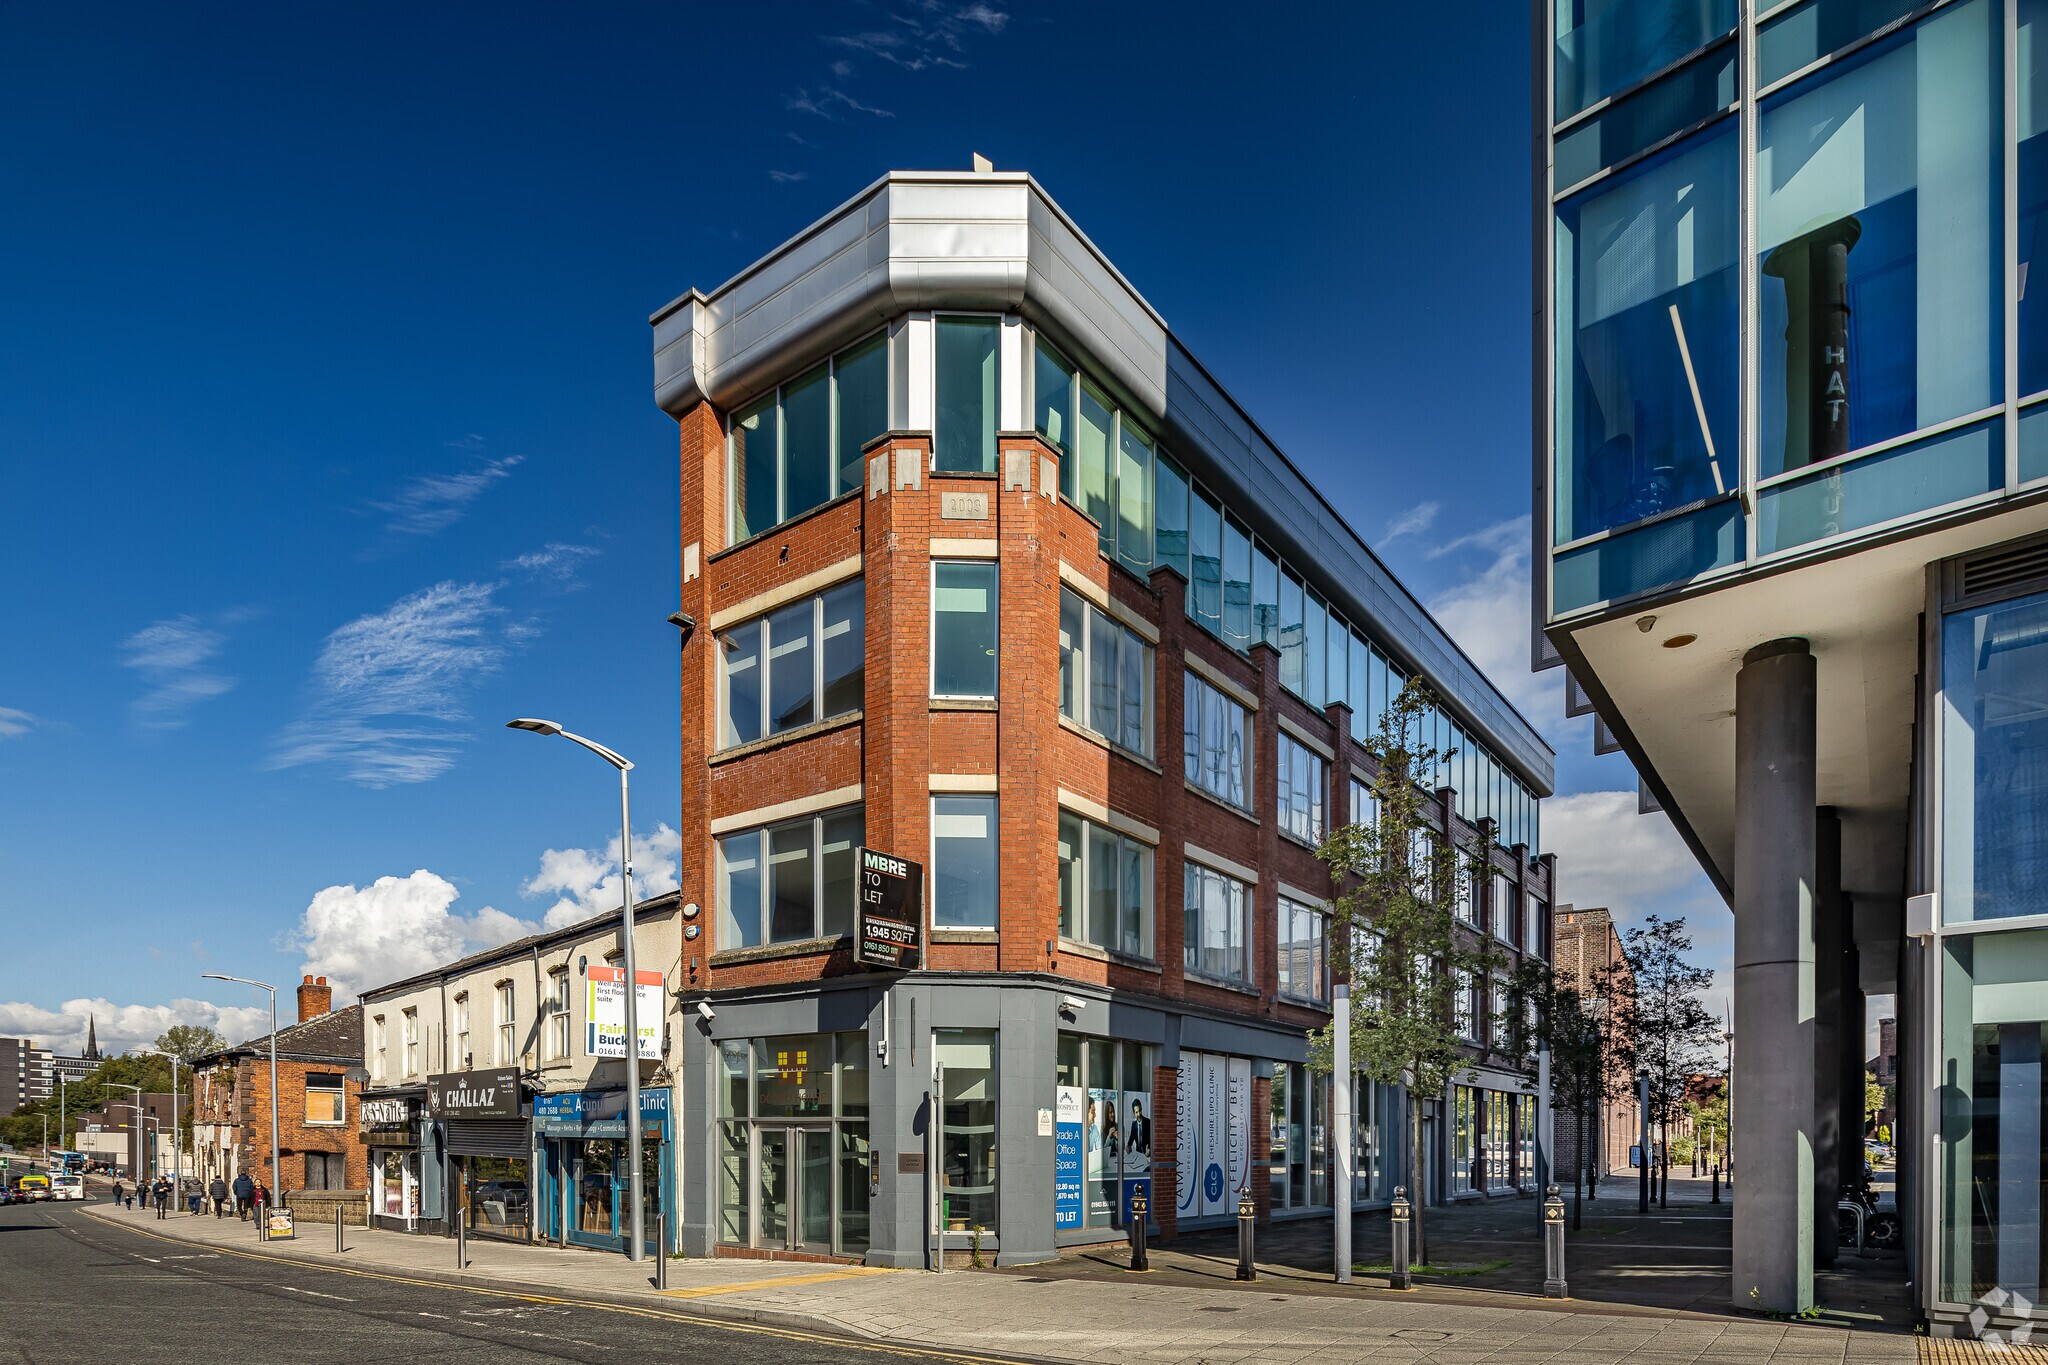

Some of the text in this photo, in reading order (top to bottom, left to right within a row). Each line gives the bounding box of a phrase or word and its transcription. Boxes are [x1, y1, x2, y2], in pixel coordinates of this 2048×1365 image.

[865, 852, 907, 877] MBRE
[865, 871, 881, 886] TO
[864, 889, 883, 904] LET
[865, 925, 889, 939] 1,945
[864, 941, 878, 951] 0161
[878, 943, 890, 953] 850
[598, 1047, 616, 1055] 0161
[446, 1087, 496, 1108] CHALLAZ
[1074, 1130, 1080, 1140] A
[1229, 1076, 1238, 1182] FELICITY BEE
[1056, 1143, 1076, 1155] Office
[1056, 1158, 1077, 1171] Space
[1176, 1160, 1184, 1198] AMY
[1056, 1211, 1077, 1223] TO LET
